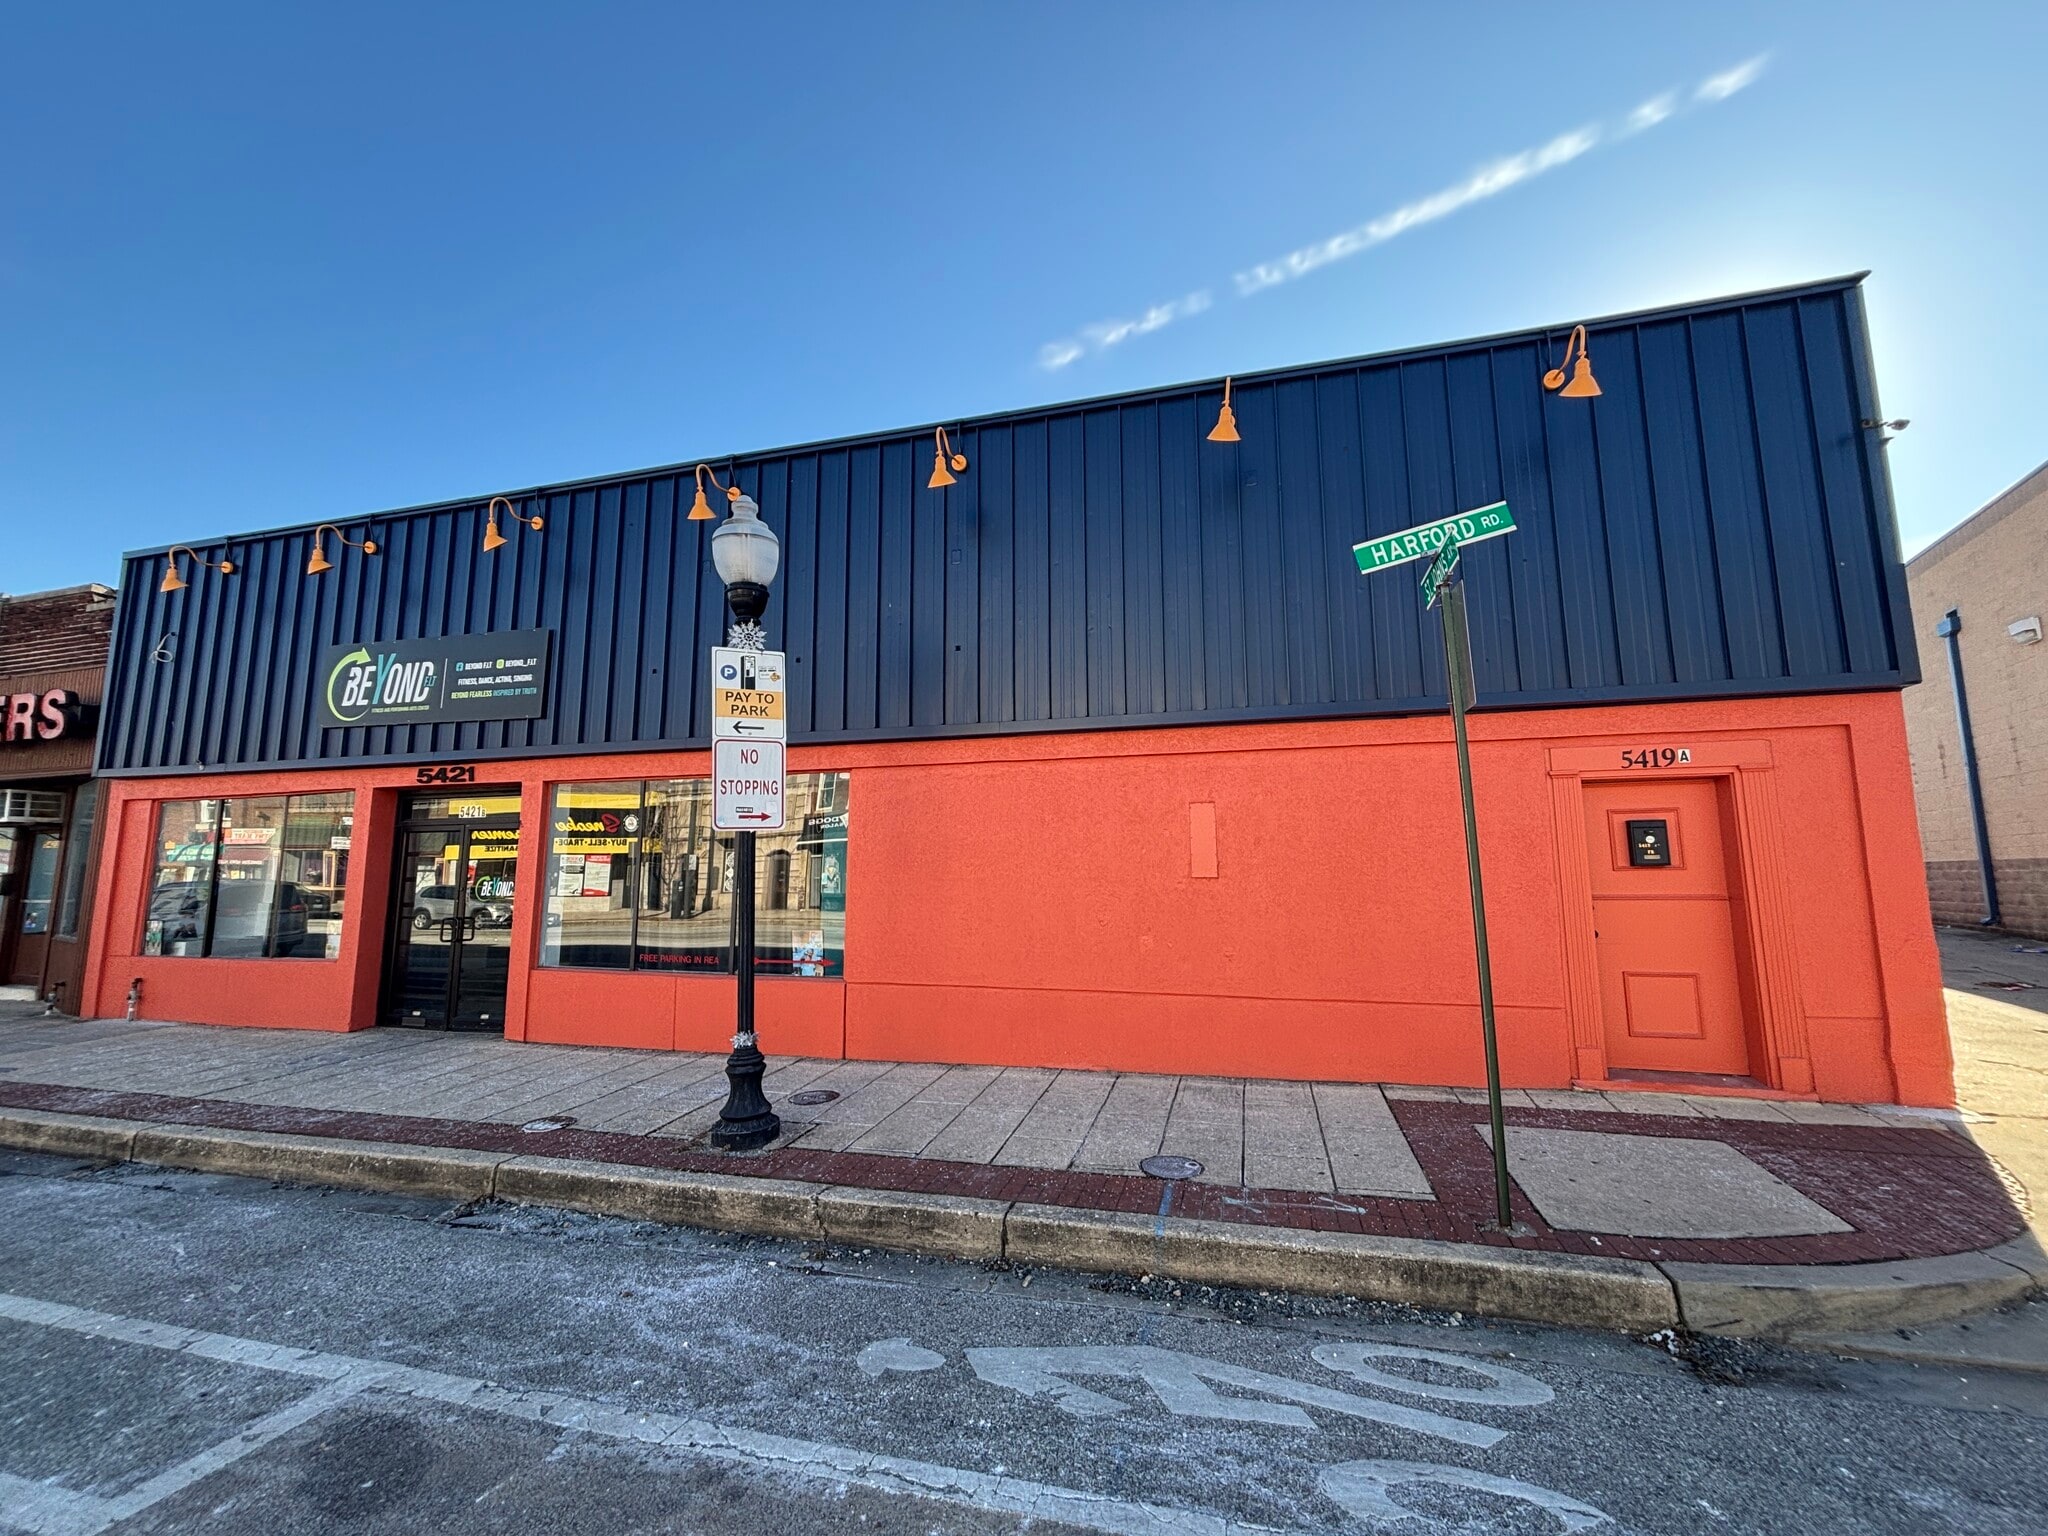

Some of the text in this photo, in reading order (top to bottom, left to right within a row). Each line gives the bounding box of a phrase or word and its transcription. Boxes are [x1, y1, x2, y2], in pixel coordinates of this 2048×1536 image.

[1371, 518, 1476, 565] HARFORD
[1480, 513, 1504, 529] RD.
[341, 653, 434, 706] BEYOND
[469, 690, 492, 698] FEARLESS
[493, 688, 514, 696] INSPIRED
[725, 691, 775, 704] PAY TO
[0, 688, 66, 741] RS
[731, 704, 769, 717] PARK
[740, 749, 759, 765] NO
[1621, 748, 1676, 769] 5419
[416, 766, 476, 784] 5421
[720, 779, 779, 795] STOPPING
[640, 954, 658, 962] FREE
[660, 954, 692, 963] PARKING
[693, 955, 702, 964] IN
